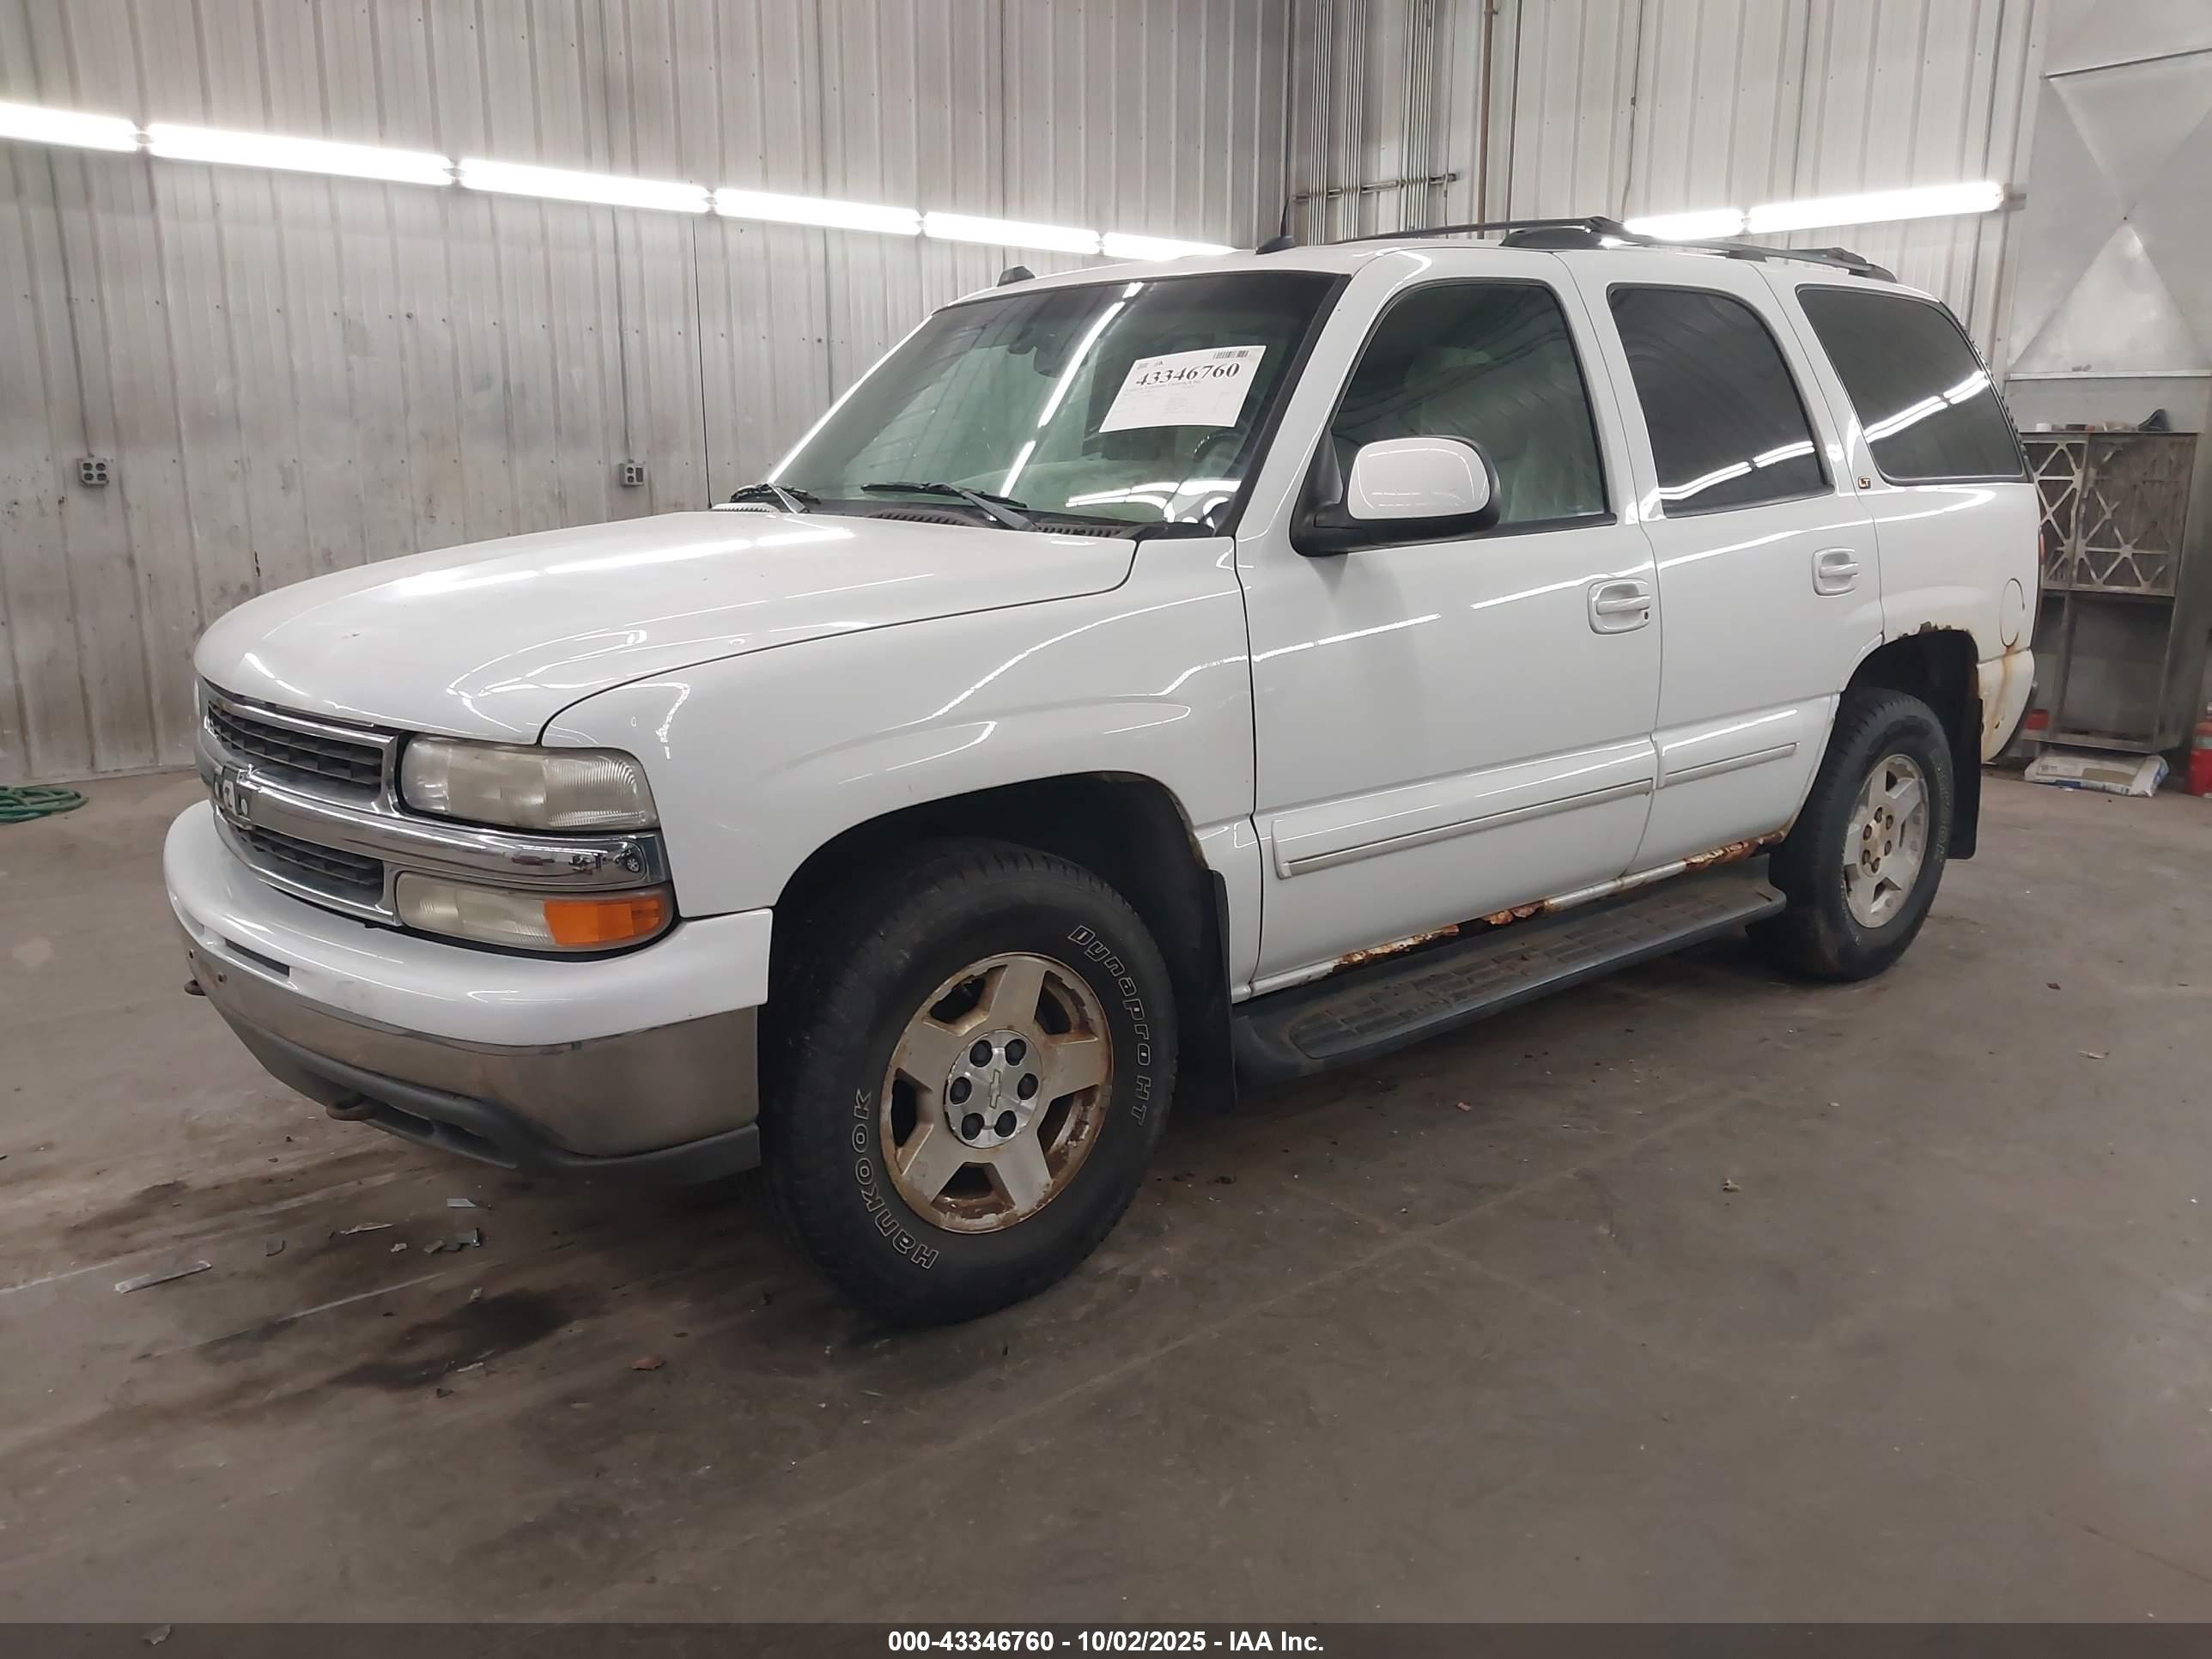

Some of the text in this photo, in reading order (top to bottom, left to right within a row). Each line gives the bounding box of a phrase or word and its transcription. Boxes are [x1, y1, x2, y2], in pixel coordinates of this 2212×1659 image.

[1135, 362, 1240, 386] 43346760
[1858, 477, 1869, 488] LT
[1067, 924, 1152, 1126] Dynapro HT
